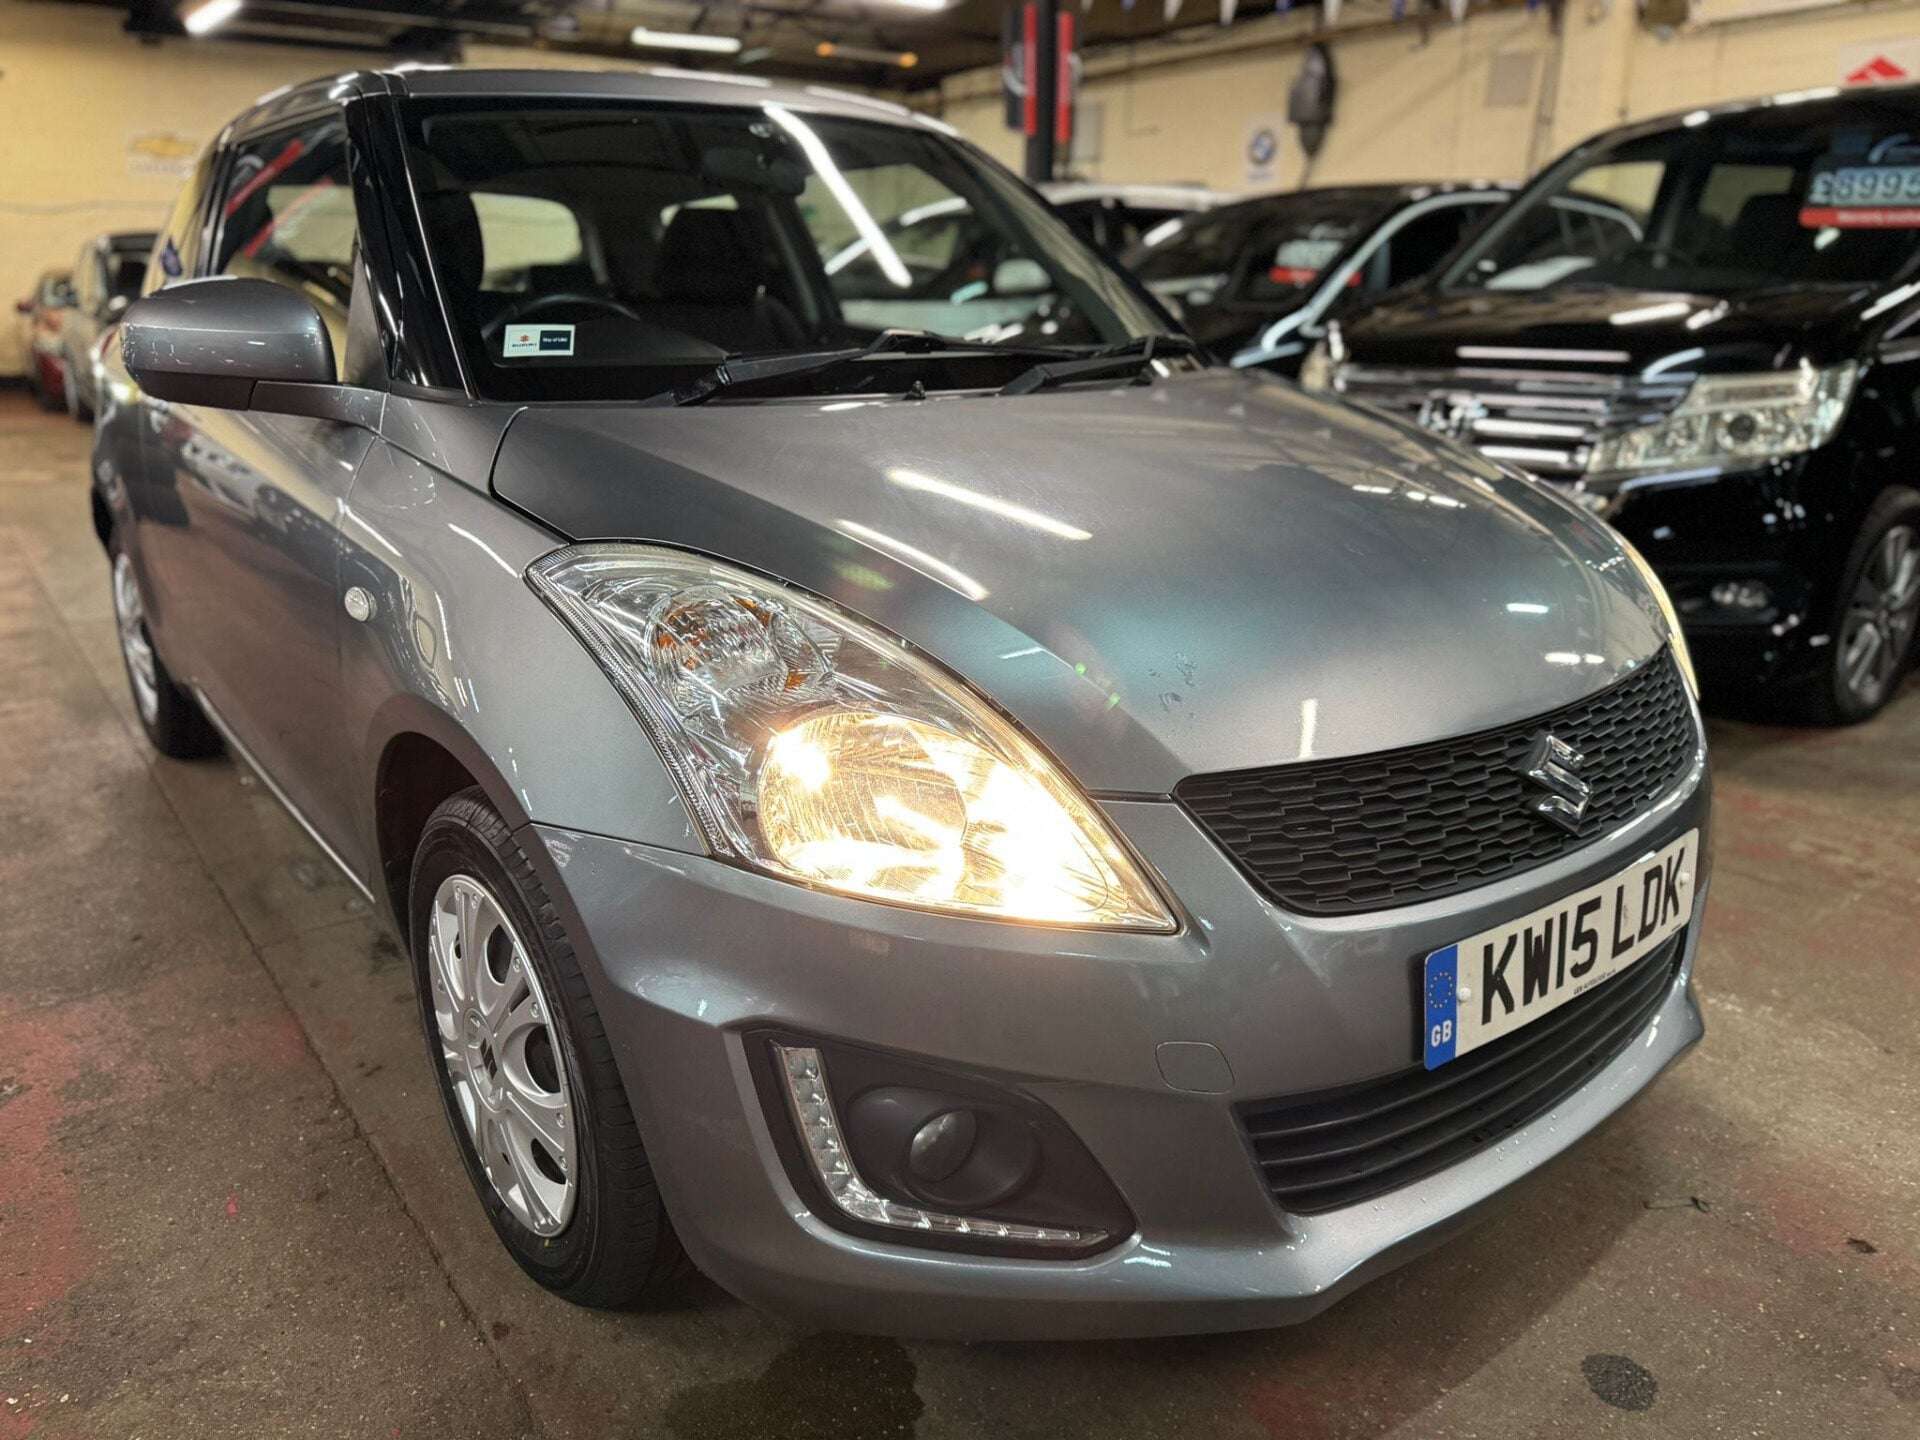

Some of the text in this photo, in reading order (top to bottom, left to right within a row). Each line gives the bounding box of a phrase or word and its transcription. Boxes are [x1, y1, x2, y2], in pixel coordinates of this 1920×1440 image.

[1481, 847, 1686, 1026] KW15 LDK
[1430, 1019, 1453, 1048] GB
